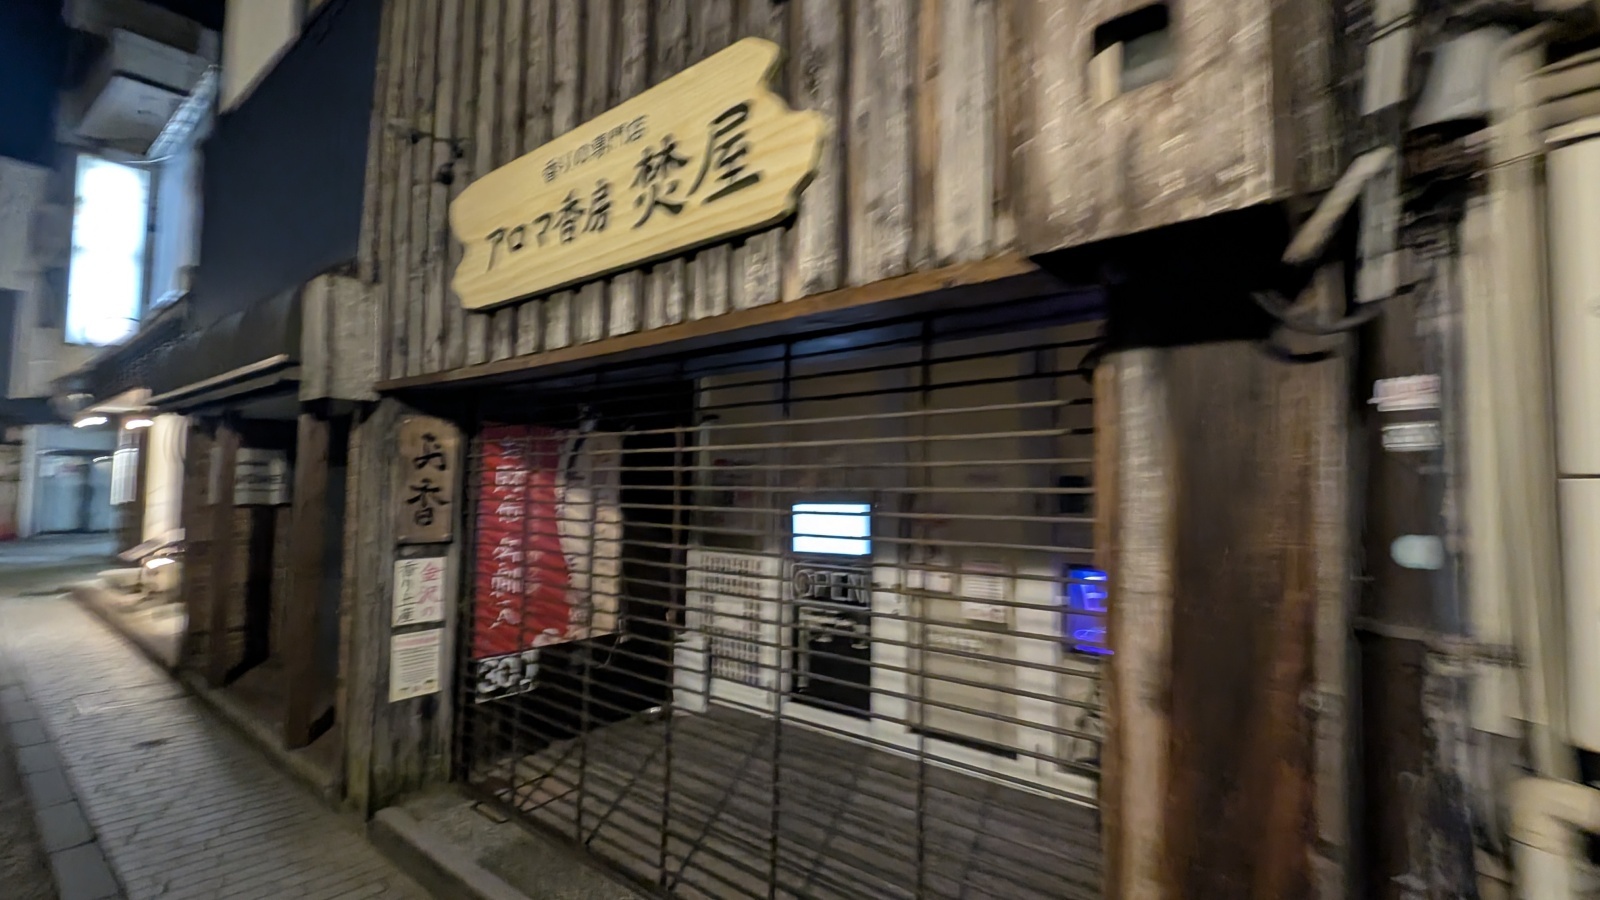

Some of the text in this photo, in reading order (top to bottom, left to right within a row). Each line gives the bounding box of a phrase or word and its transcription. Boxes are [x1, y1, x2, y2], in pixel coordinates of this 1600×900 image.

[541, 114, 649, 184] 香りの専門店
[484, 99, 764, 271] アロマ香房 焚屋
[793, 568, 870, 604] OPEN
